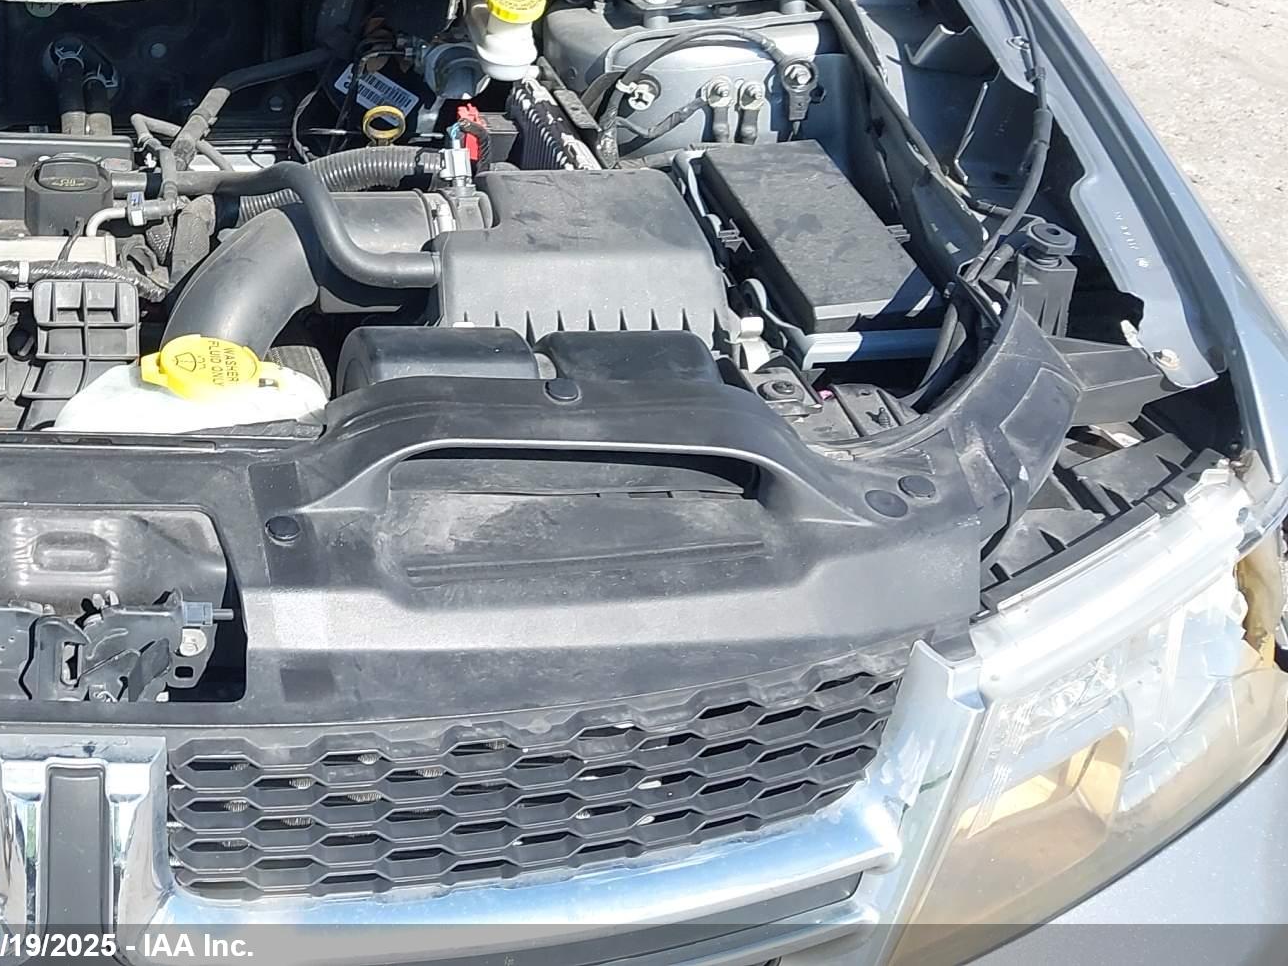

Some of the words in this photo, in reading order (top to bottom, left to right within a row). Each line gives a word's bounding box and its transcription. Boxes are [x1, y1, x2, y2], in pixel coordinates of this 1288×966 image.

[208, 340, 222, 364] FLUID
[211, 365, 225, 387] ONLY
[223, 347, 240, 383] WASHER
